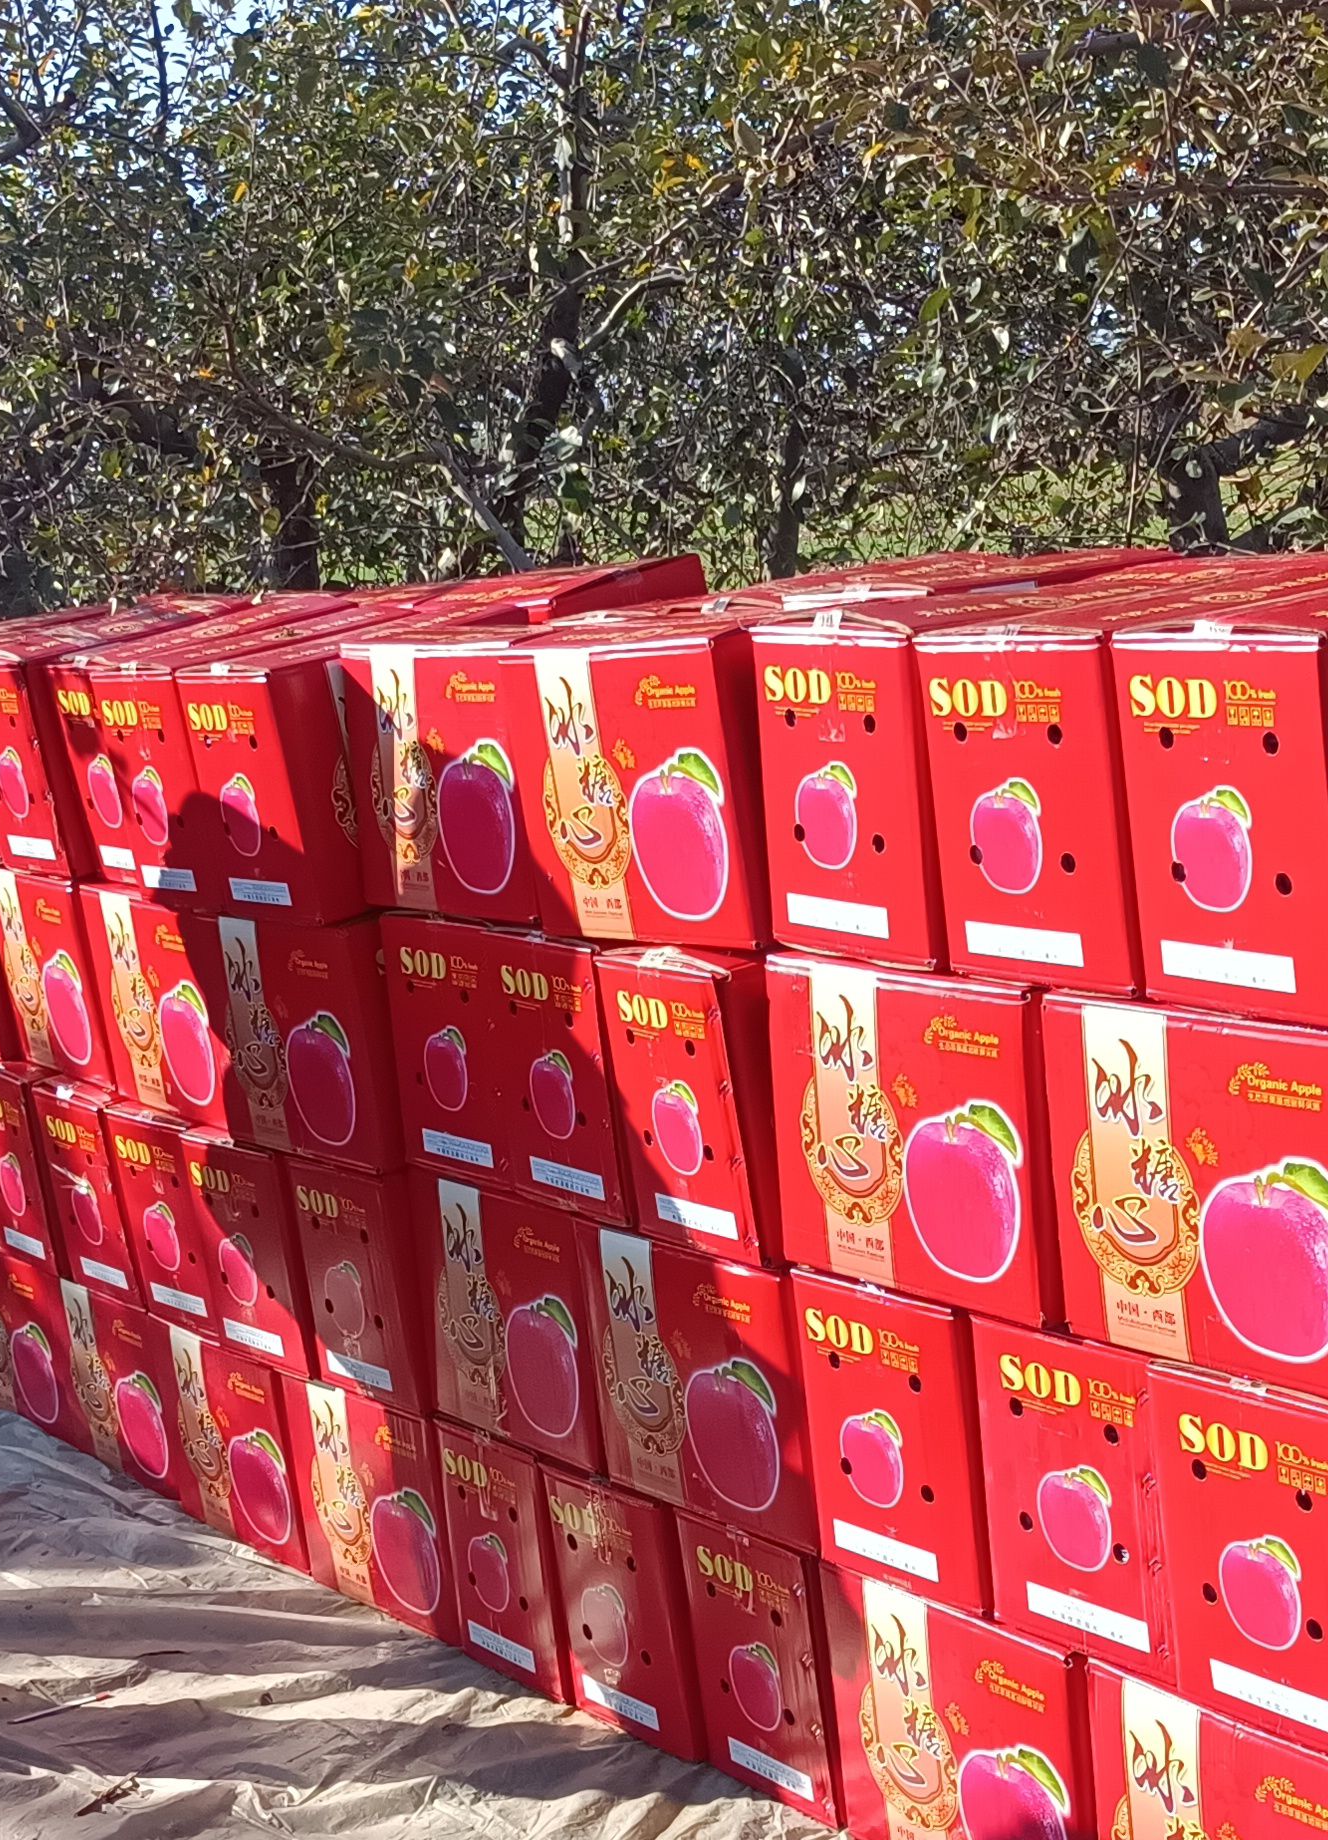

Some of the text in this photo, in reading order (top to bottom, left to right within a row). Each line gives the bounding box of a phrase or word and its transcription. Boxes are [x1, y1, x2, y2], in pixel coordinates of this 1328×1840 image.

[764, 665, 831, 704] SOD
[929, 677, 1007, 717] SOD
[1129, 674, 1217, 719] SOD
[57, 689, 91, 716] SOD
[101, 700, 138, 727] SOD
[188, 703, 228, 731] SOD
[400, 947, 446, 980] SOD
[501, 965, 549, 1001] SOD
[617, 990, 668, 1029] SOD
[938, 1026, 999, 1046] Organic Apple
[1247, 1075, 1322, 1097] Organic Apple
[46, 1115, 77, 1144] SOD
[114, 1135, 151, 1165] SOD
[189, 1161, 230, 1193] SOD
[296, 1185, 339, 1218] SOD
[805, 1307, 874, 1355] SOD
[999, 1354, 1081, 1406] SOD
[1179, 1413, 1269, 1471] SOD
[444, 1448, 488, 1487] SOD
[697, 1546, 753, 1592] SOD
[1272, 1789, 1312, 1812] Organic
